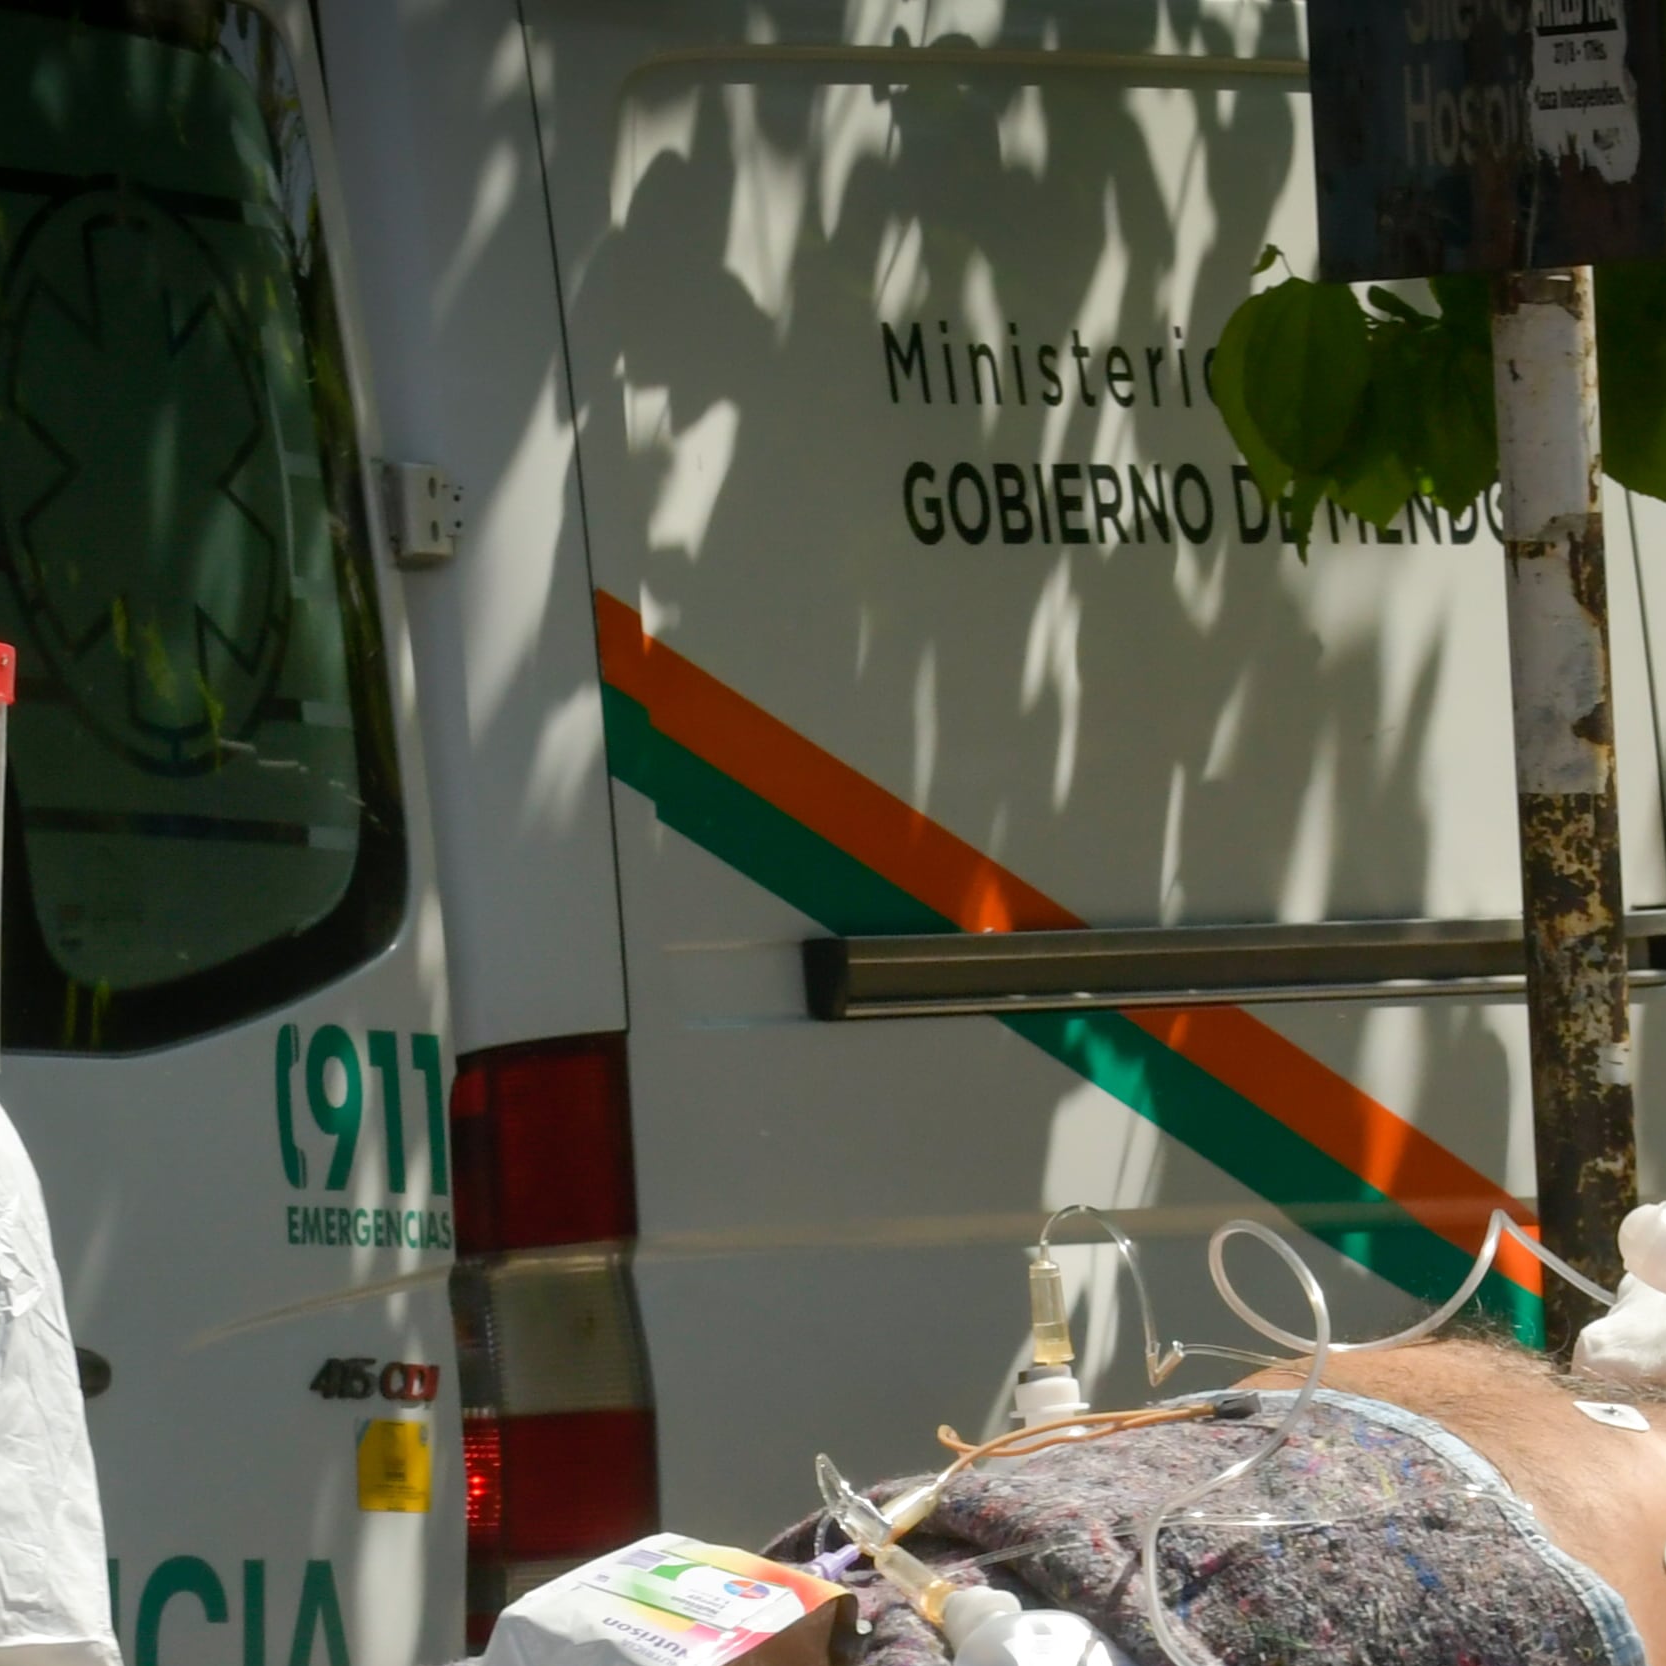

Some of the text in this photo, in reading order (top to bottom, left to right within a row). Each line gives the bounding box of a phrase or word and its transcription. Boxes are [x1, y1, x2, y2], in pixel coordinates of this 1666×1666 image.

[903, 461, 1214, 545] GOBIERNO
[306, 1023, 449, 1197] 911
[286, 1205, 453, 1252] EMERGENCIAS
[380, 1361, 441, 1402] CDI
